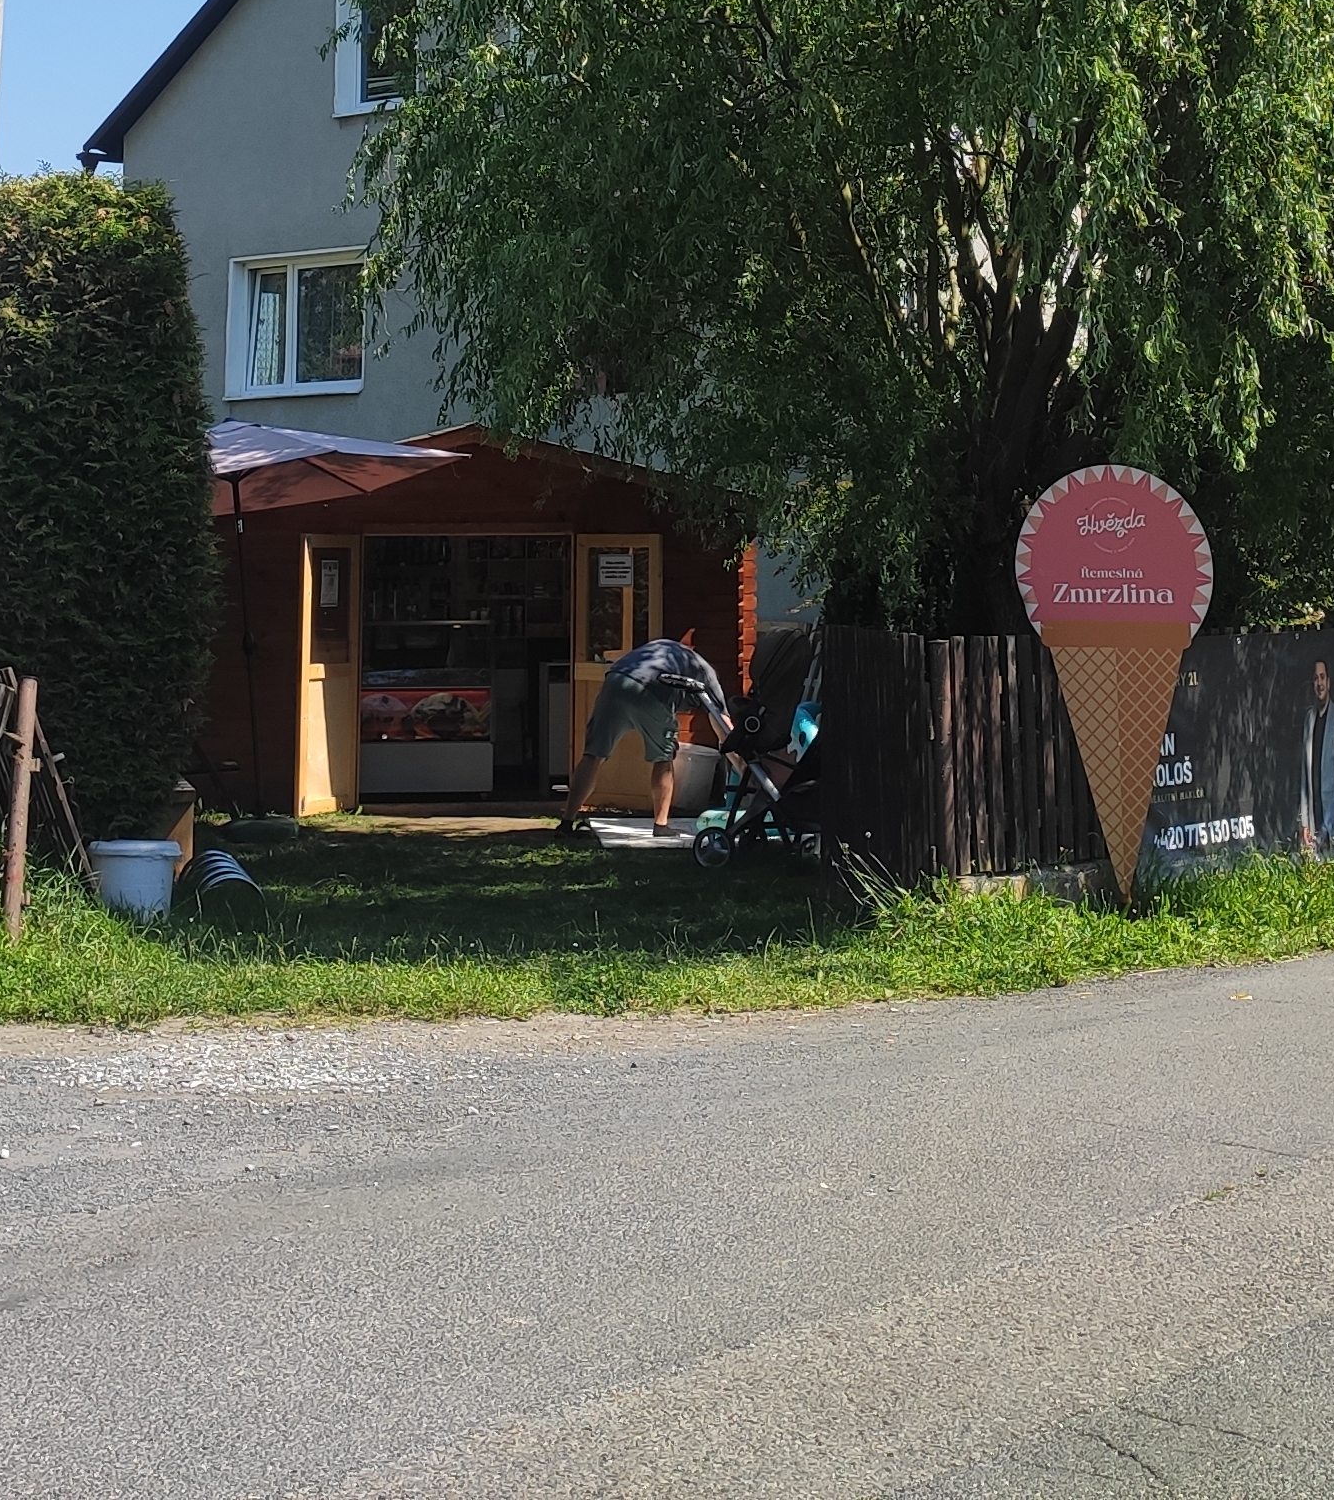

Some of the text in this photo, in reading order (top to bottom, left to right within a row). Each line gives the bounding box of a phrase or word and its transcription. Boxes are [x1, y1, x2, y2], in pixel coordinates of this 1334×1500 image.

[1076, 507, 1146, 537] Hvězda
[1080, 565, 1144, 579] Řemeslná
[1052, 583, 1175, 605] Zmrzlina
[1153, 755, 1193, 788] OLOŠ
[1184, 822, 1208, 847] 775
[1207, 818, 1231, 844] 130
[1230, 815, 1255, 840] 505
